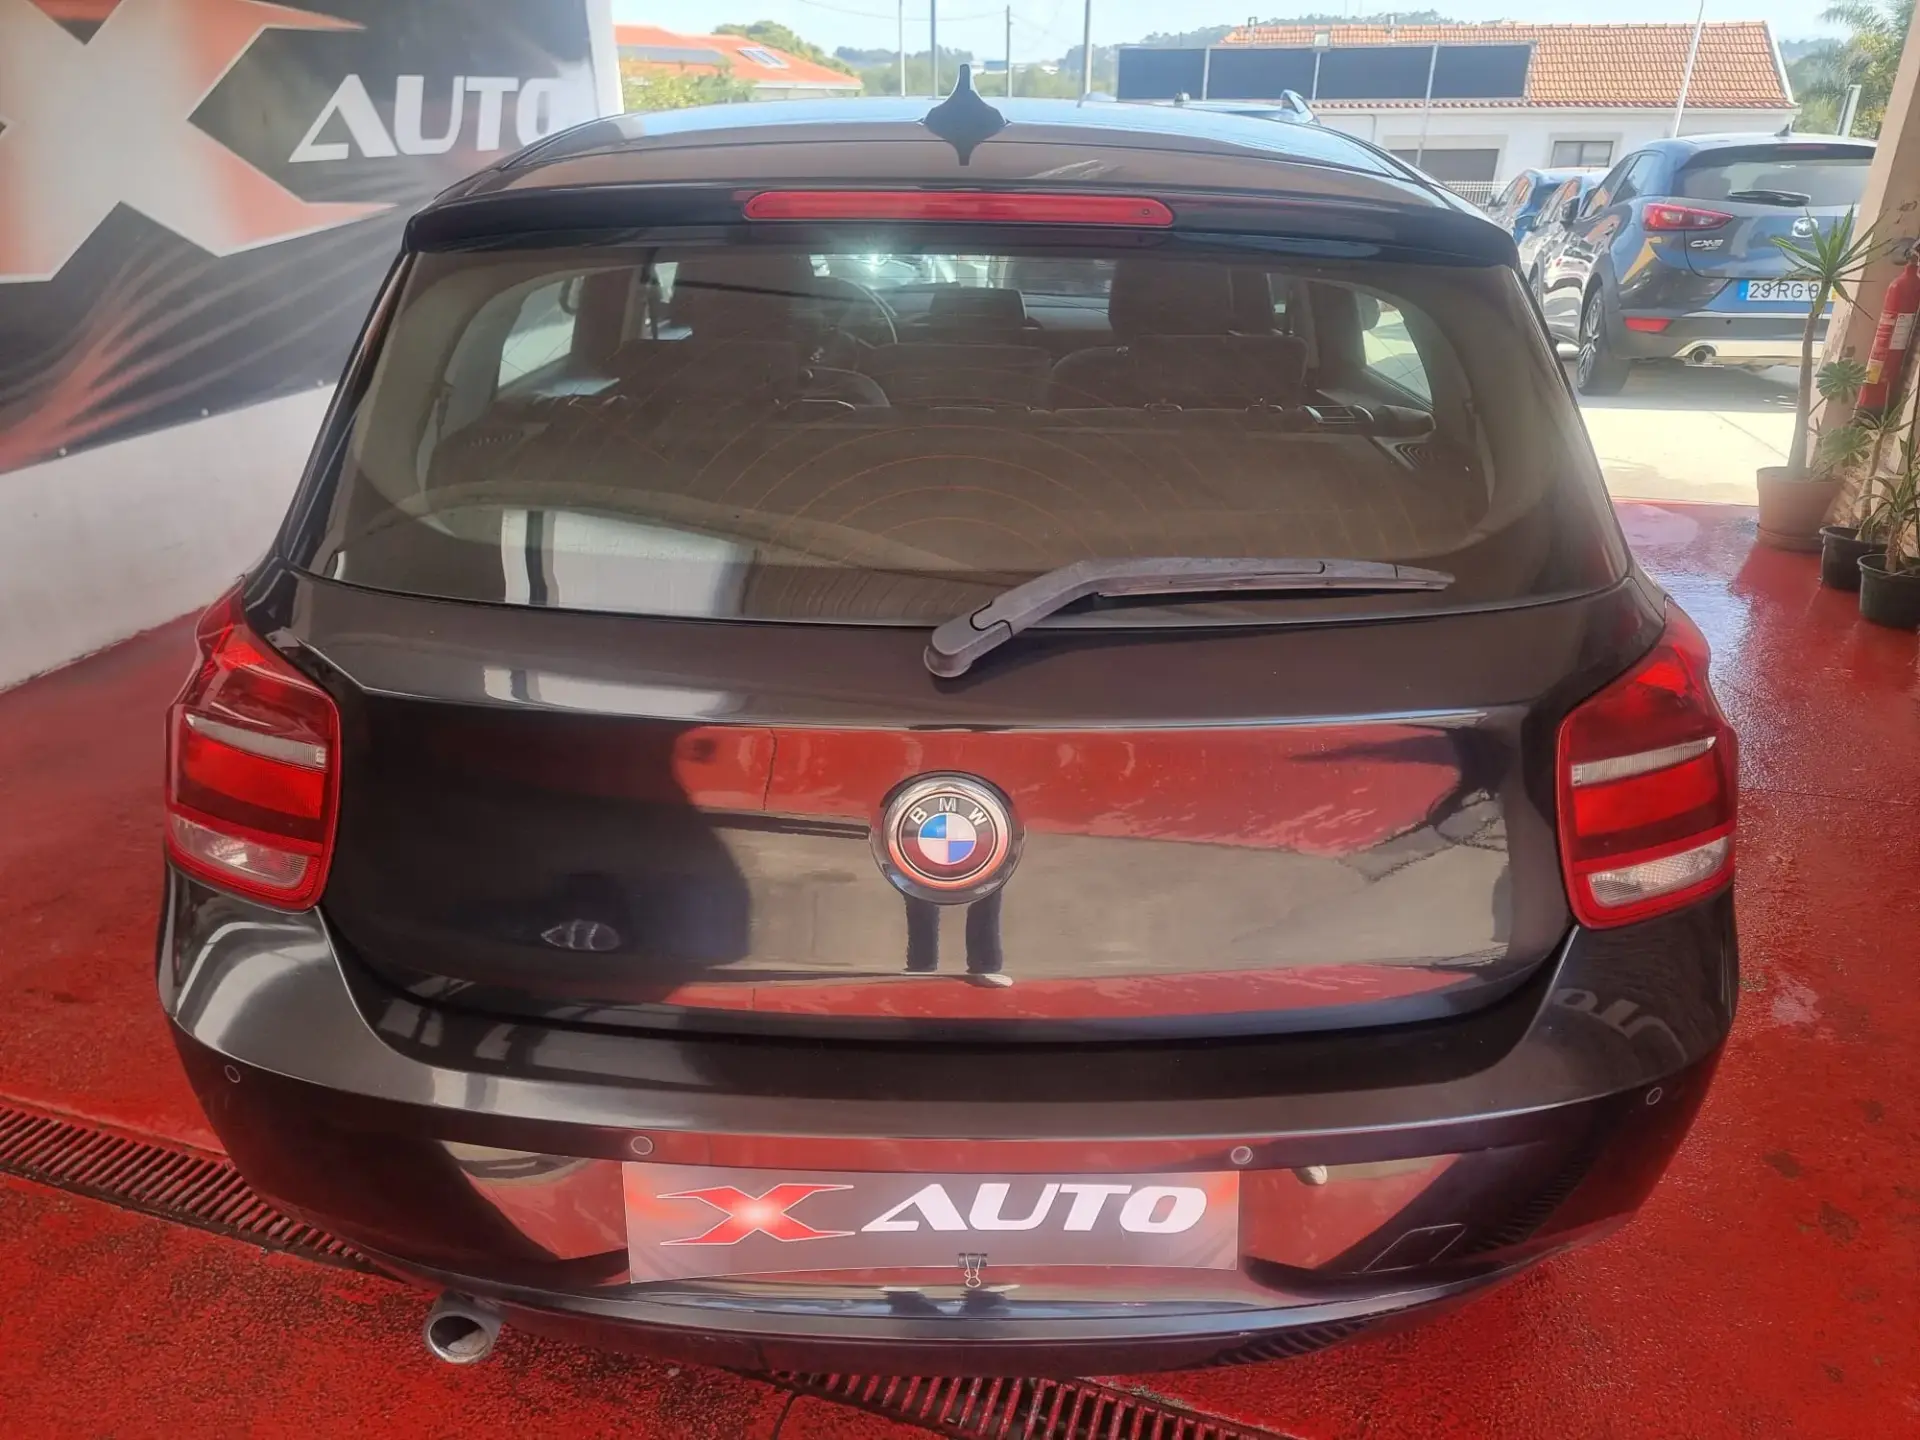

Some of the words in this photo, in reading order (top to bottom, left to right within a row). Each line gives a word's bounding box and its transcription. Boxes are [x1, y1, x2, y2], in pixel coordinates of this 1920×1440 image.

[289, 74, 569, 162] AUTO
[909, 797, 988, 826] BMW
[861, 1183, 1208, 1234] AUTO
